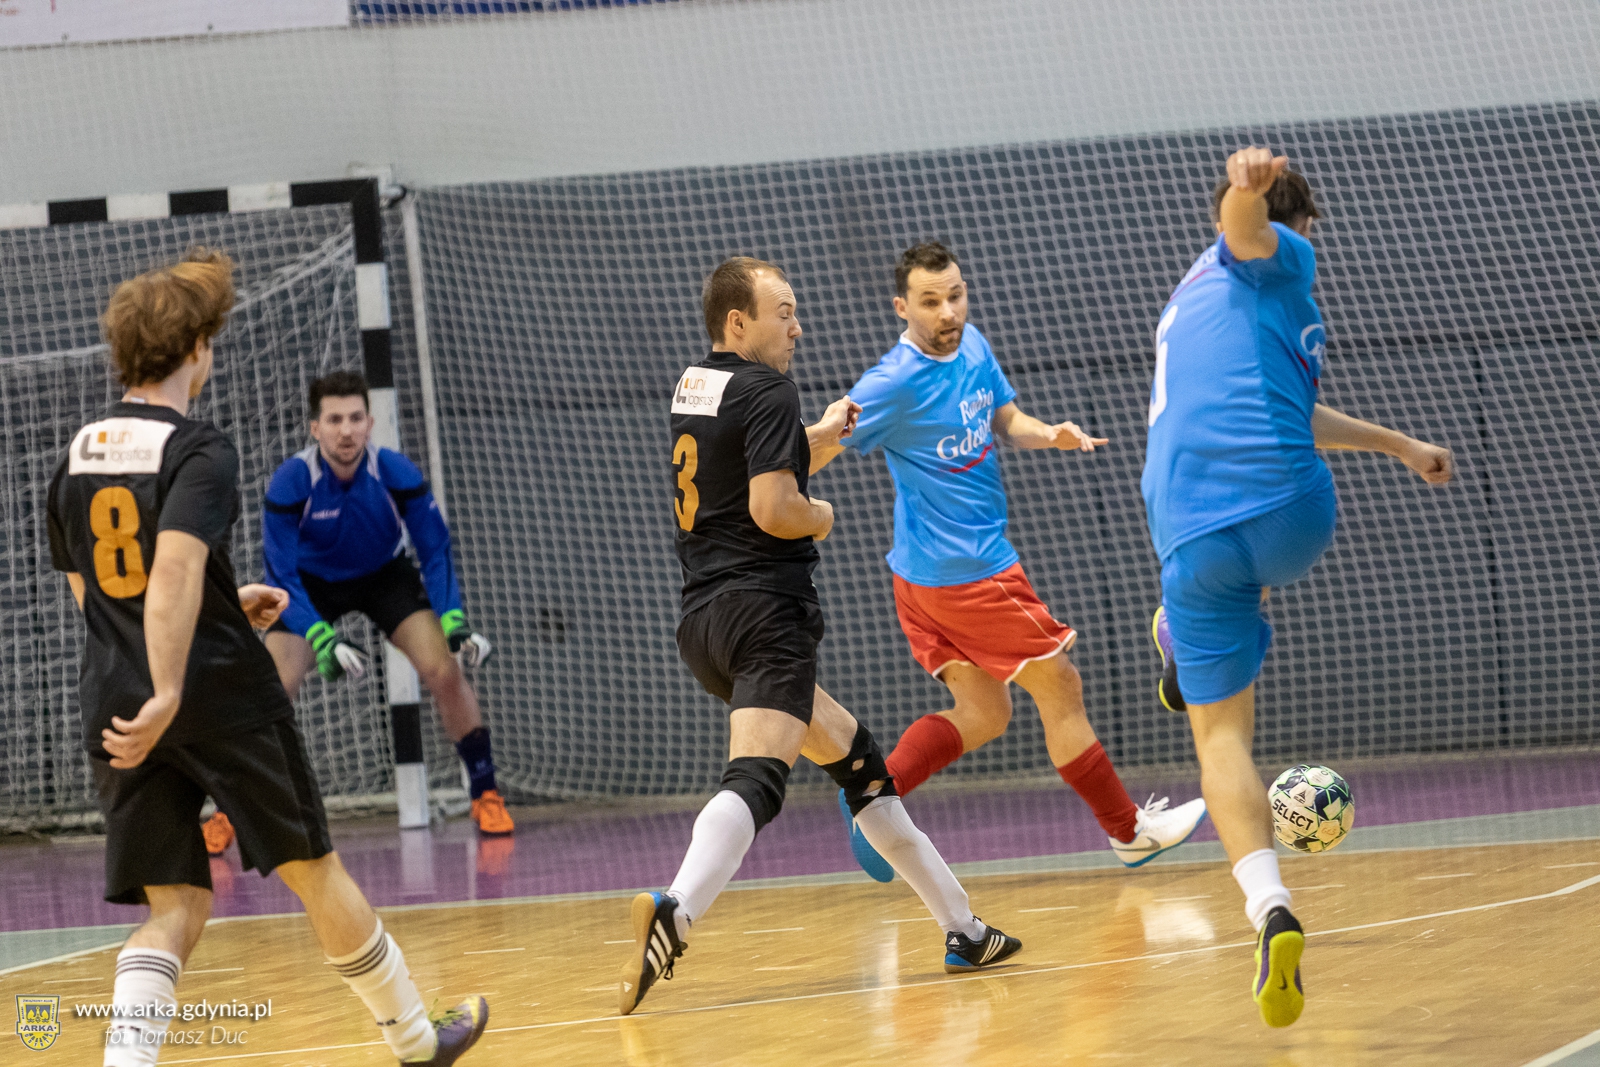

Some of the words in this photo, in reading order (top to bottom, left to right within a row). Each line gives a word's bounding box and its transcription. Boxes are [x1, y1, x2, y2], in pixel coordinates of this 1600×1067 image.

[689, 376, 707, 390] uni
[959, 387, 994, 426] Radio
[936, 409, 992, 460] Gdań
[109, 446, 152, 464] logstics
[672, 433, 699, 532] 3
[90, 486, 147, 599] 8
[1272, 798, 1314, 831] SELECT
